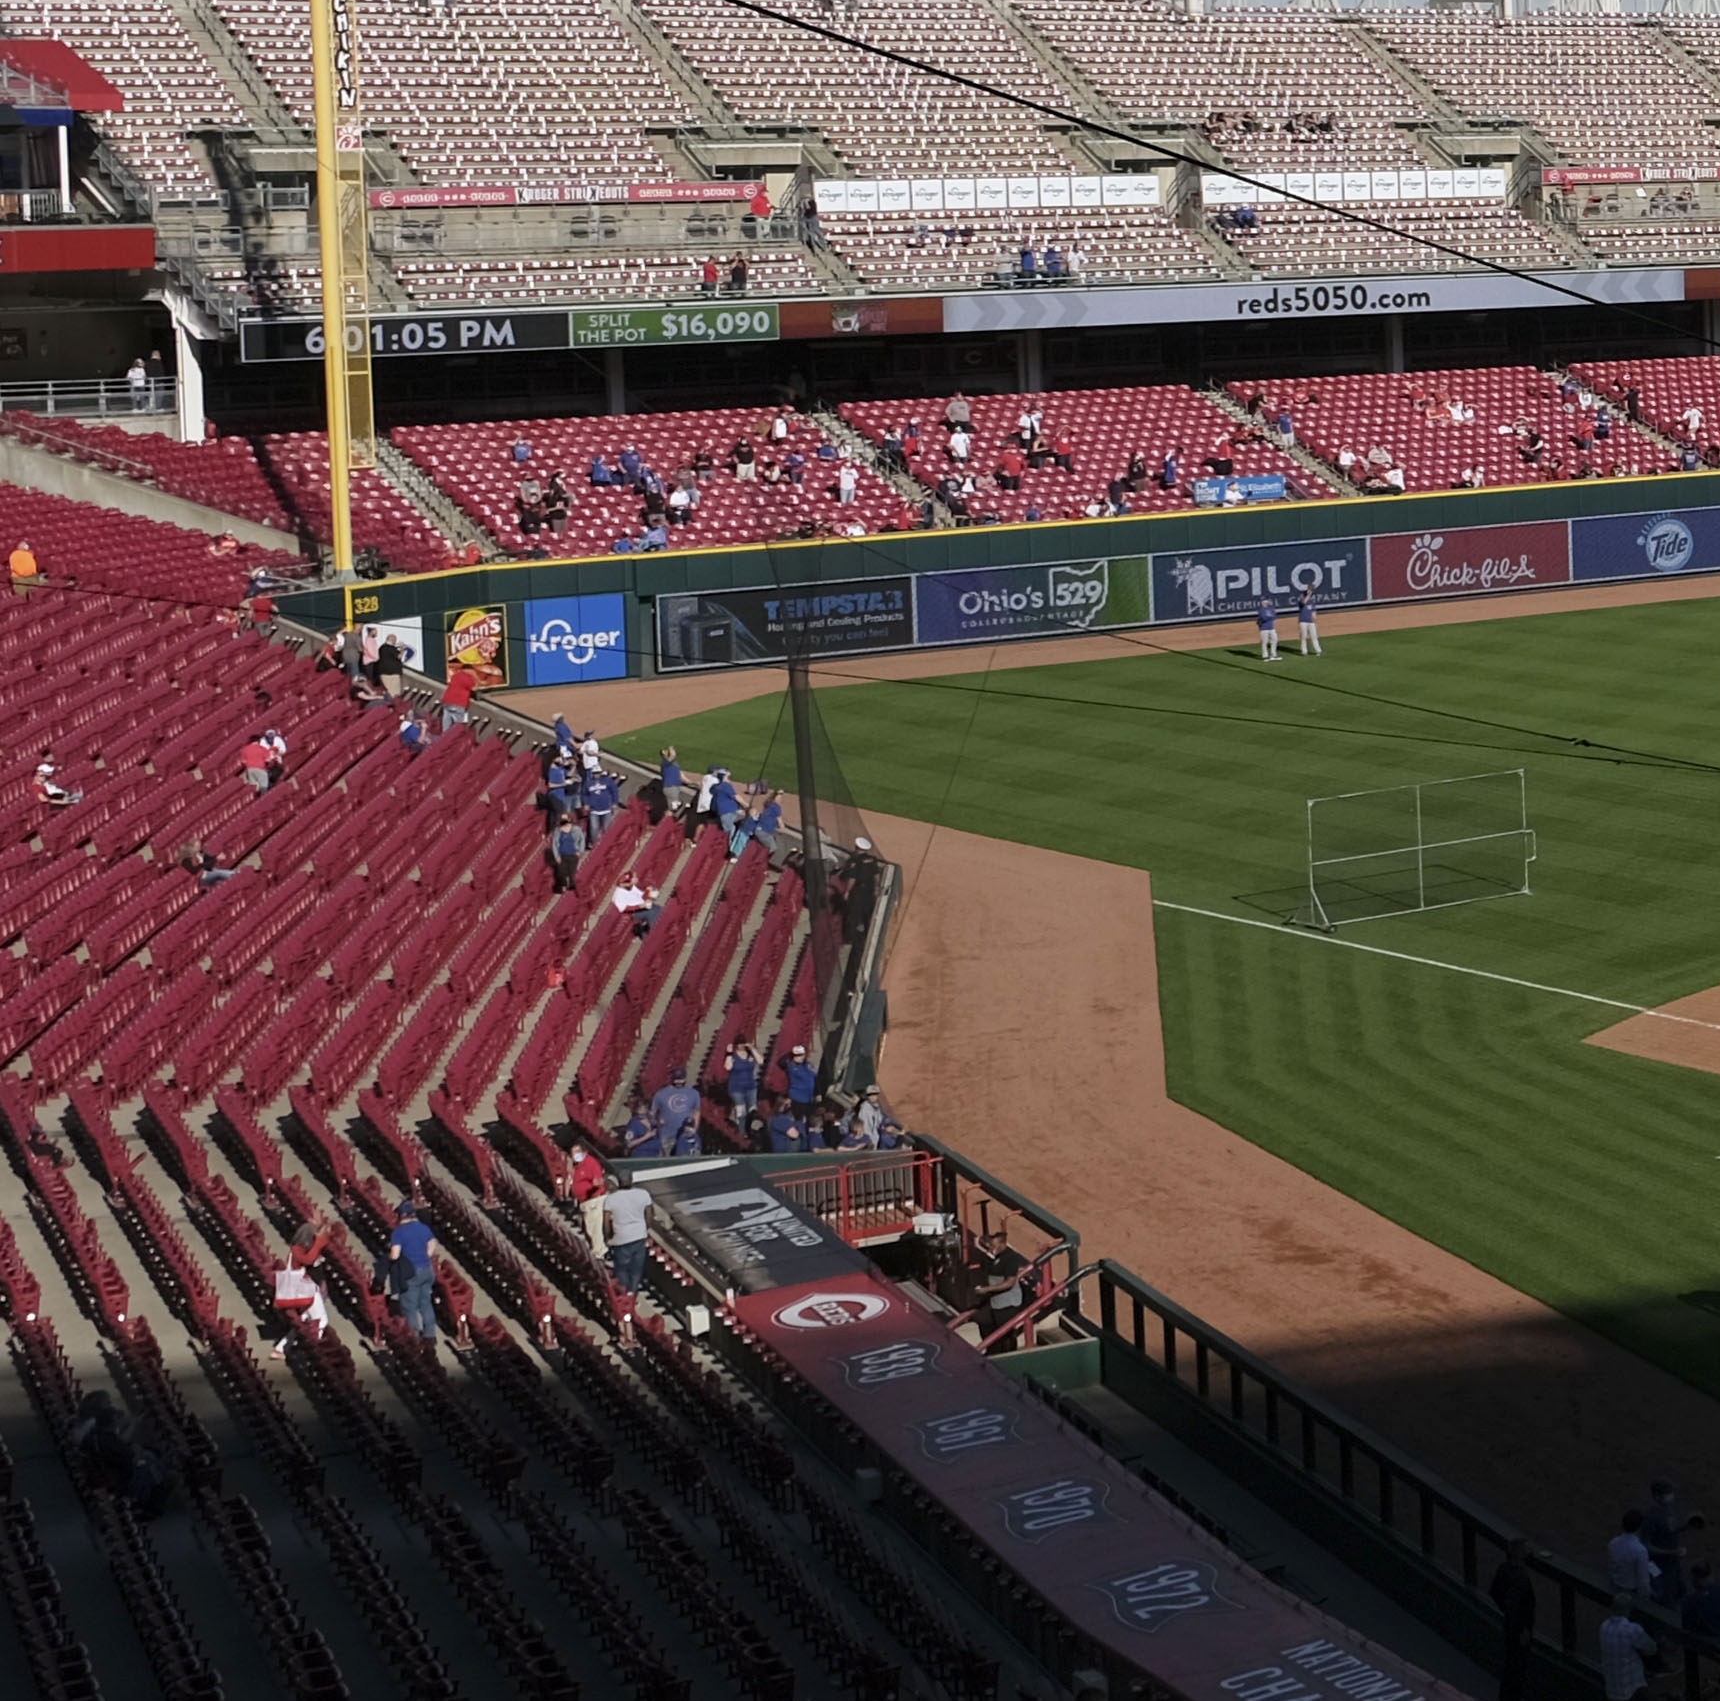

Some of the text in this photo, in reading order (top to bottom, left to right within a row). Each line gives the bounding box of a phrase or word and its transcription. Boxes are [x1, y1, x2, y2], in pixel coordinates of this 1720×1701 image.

[1237, 284, 1431, 317] reds5050.com
[459, 318, 516, 348] PM
[578, 326, 647, 344] THE POT
[588, 313, 631, 329] SPLIT
[661, 310, 771, 340] $16,090
[1651, 532, 1689, 562] Tide
[1217, 559, 1347, 599] PILOT
[1407, 543, 1535, 590] Chick-fil-A
[354, 595, 379, 614] 328
[959, 580, 1104, 615] Ohio's 529
[450, 617, 501, 653] Kahn's
[530, 619, 620, 664] Kroger
[1009, 1479, 1096, 1533] 1970
[1110, 1563, 1211, 1623] 1972
